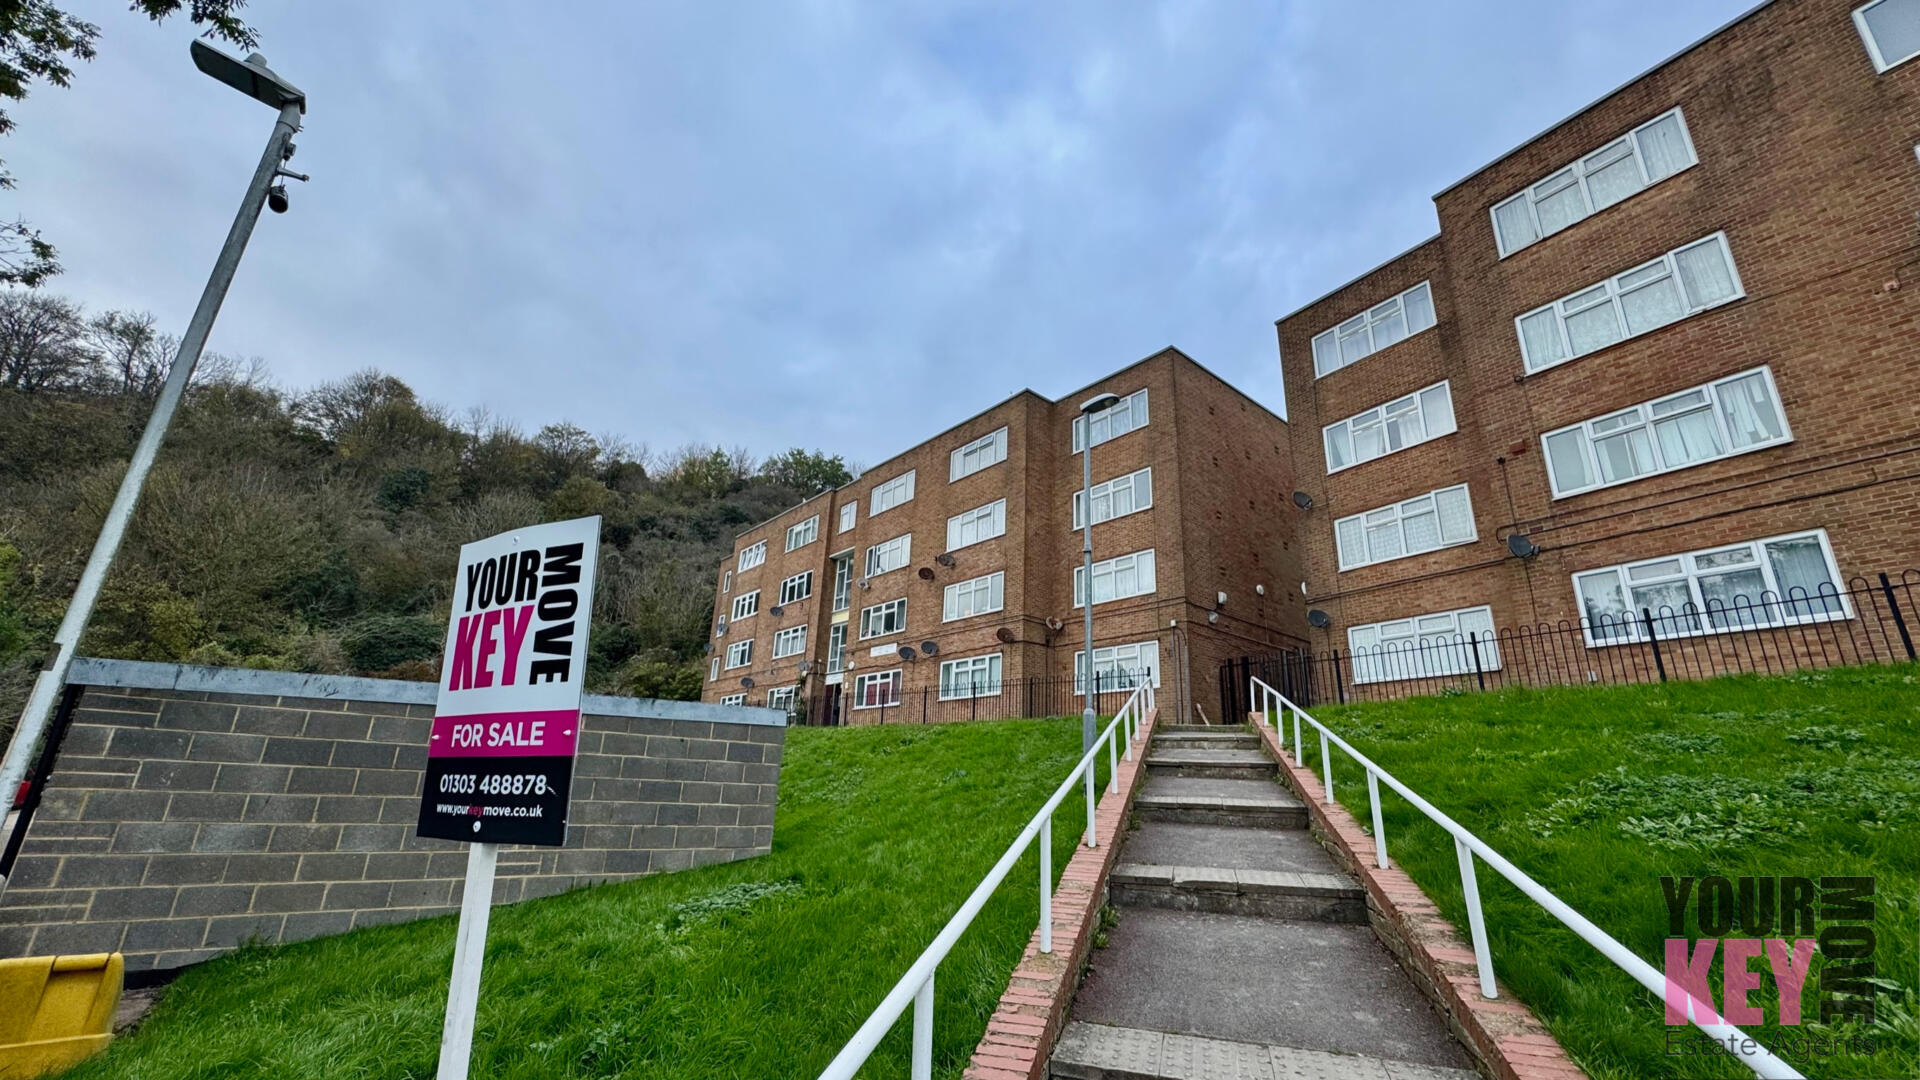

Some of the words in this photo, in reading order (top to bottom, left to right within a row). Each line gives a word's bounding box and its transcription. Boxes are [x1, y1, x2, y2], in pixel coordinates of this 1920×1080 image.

[465, 549, 541, 612] YOUR
[529, 542, 584, 685] MOVE
[448, 604, 534, 691] KEY
[451, 723, 484, 748] FOR
[487, 721, 546, 747] SALE
[439, 774, 477, 794] 01303
[479, 774, 547, 795] 488878
[436, 803, 543, 818] www.yourkeymove.co.uk
